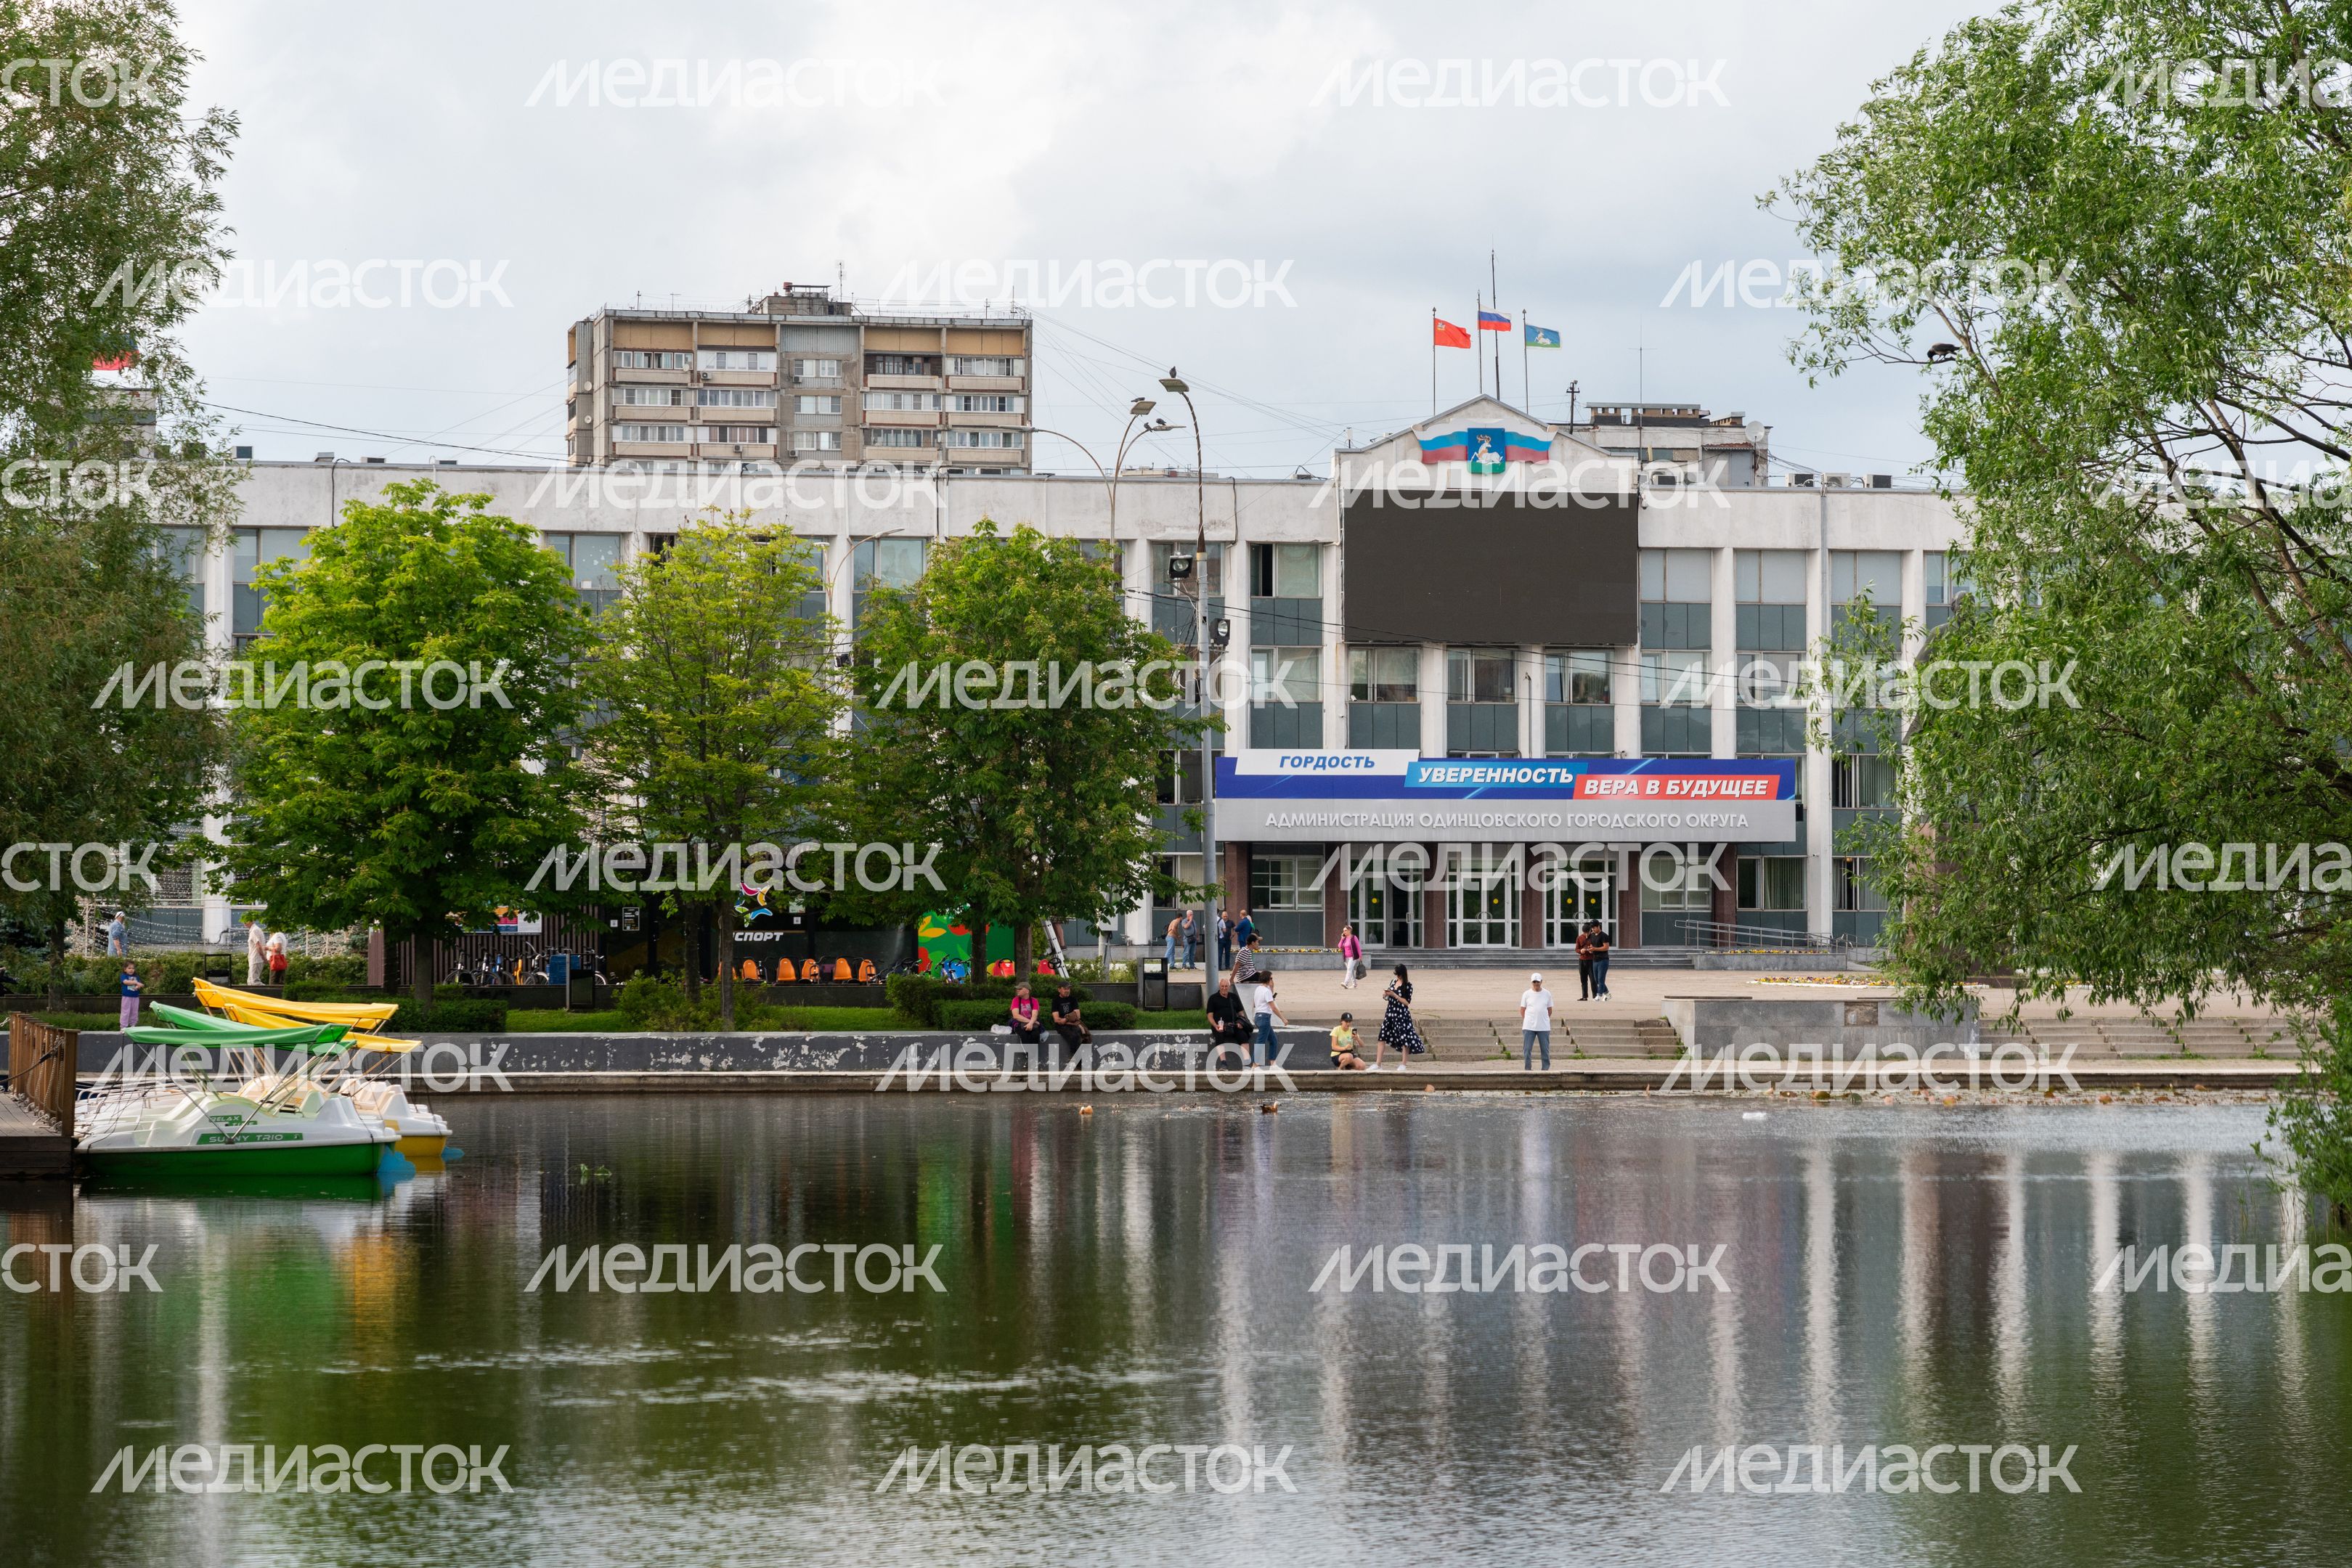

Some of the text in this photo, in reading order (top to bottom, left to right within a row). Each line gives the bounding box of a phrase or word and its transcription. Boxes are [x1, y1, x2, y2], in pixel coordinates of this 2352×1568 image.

[1279, 756, 1375, 770] ГОРДОСТЬ
[1418, 767, 1574, 783] УВЕРЕННОСТЬ
[1584, 779, 1769, 798] ВЕРА В БУДУЩЕЕ
[1265, 812, 1749, 828] АДМИНИСТРАЦИЯ ОДИНЦОВСКОГО ГОРОДСКОГО ОКРУГА
